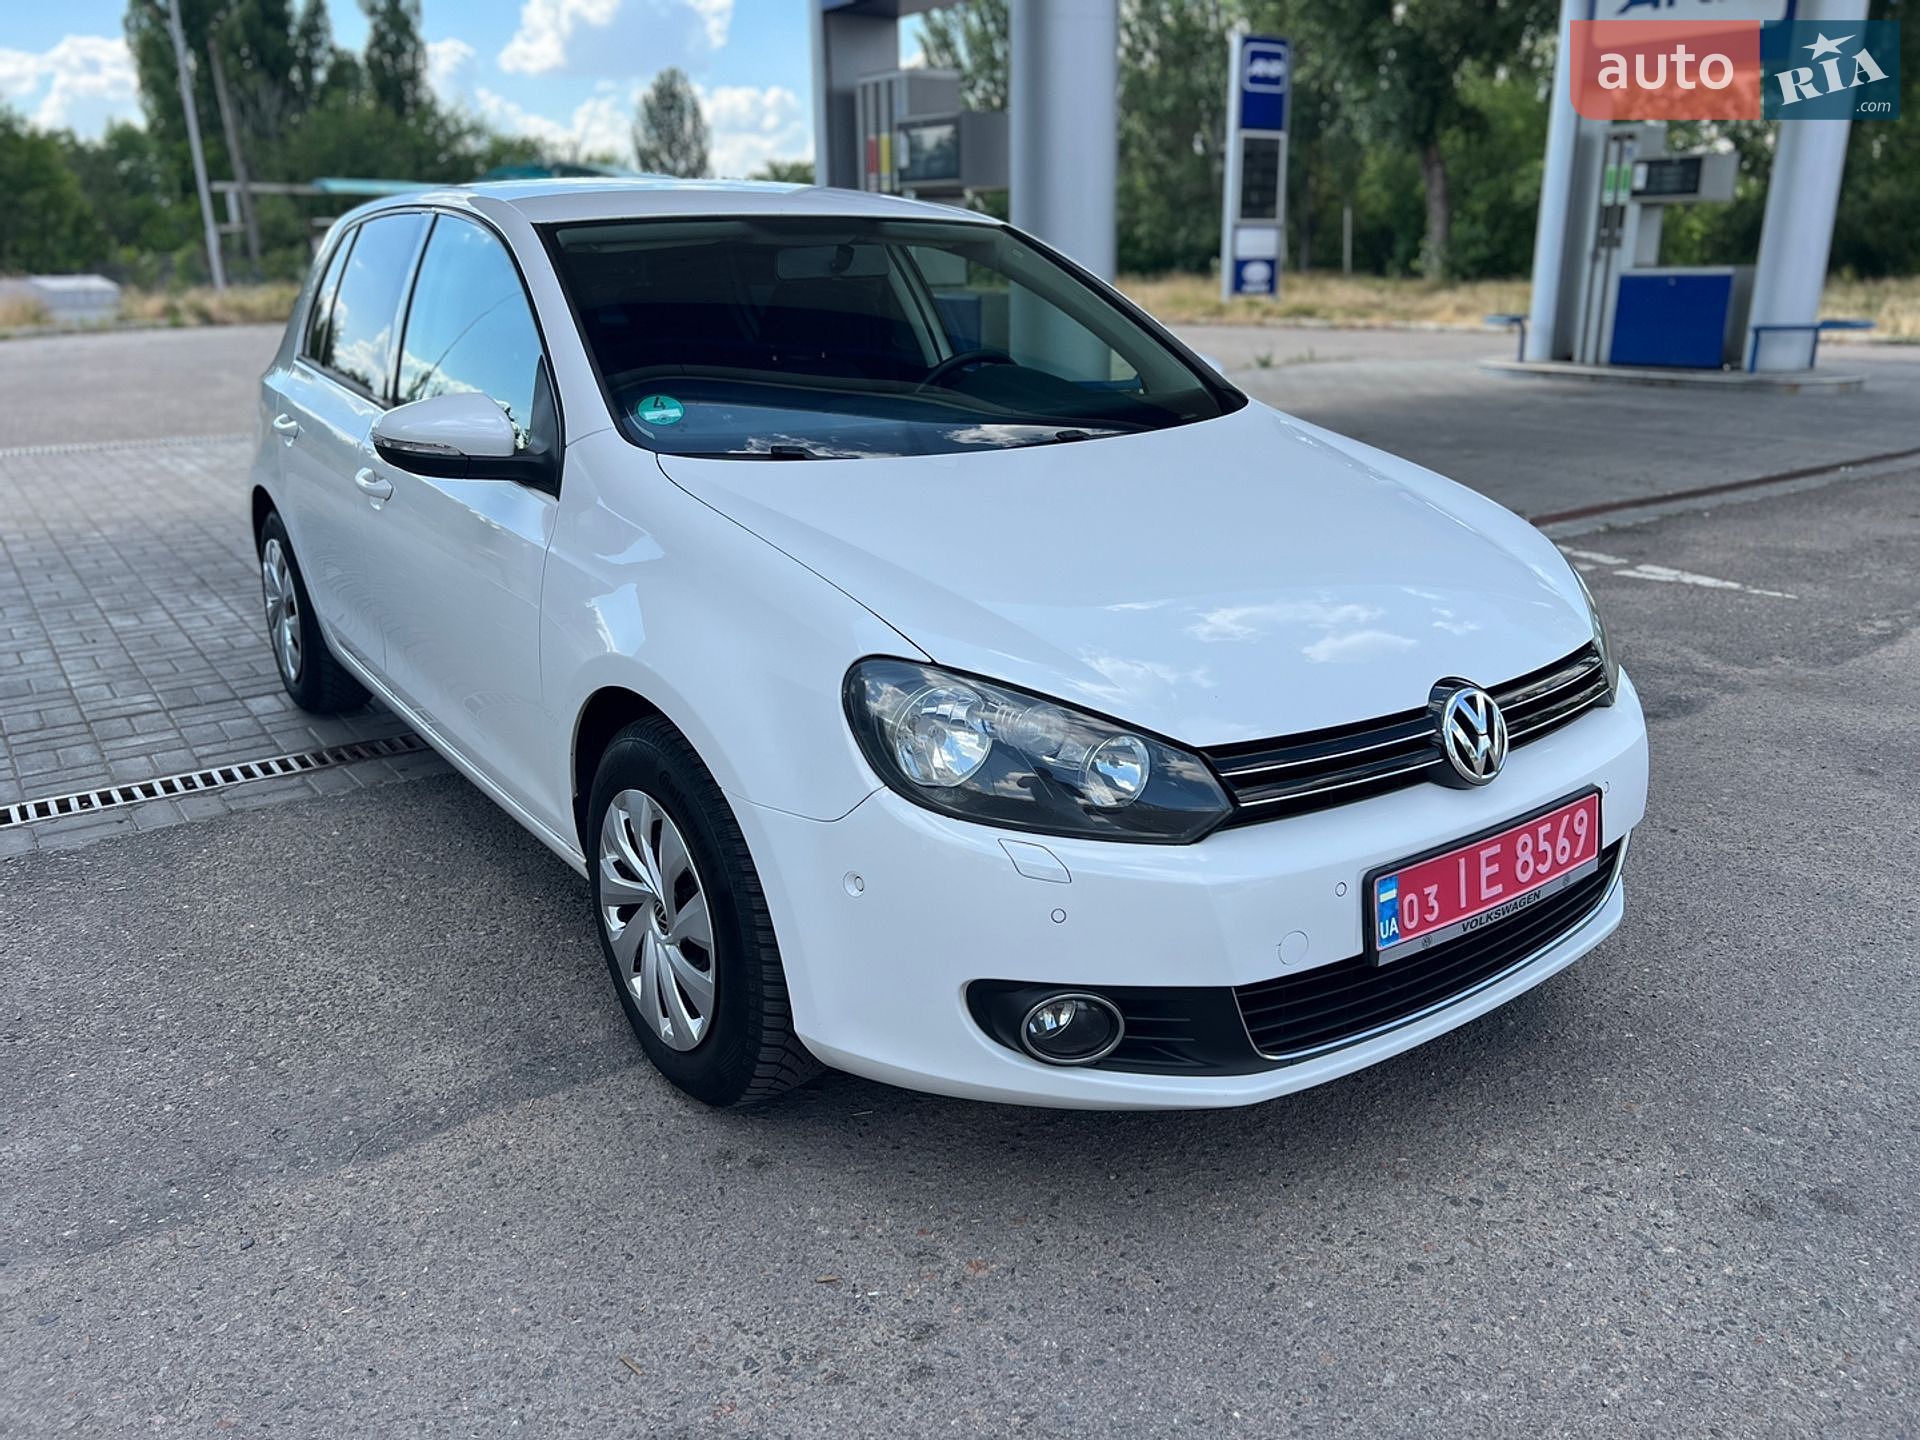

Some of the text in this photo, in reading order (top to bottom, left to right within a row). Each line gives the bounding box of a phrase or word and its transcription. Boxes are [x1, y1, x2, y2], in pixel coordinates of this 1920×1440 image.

[653, 396, 667, 410] 4
[1379, 808, 1588, 939] UA 03 IE 8569
[1461, 889, 1542, 932] VOLKSWAGEN
